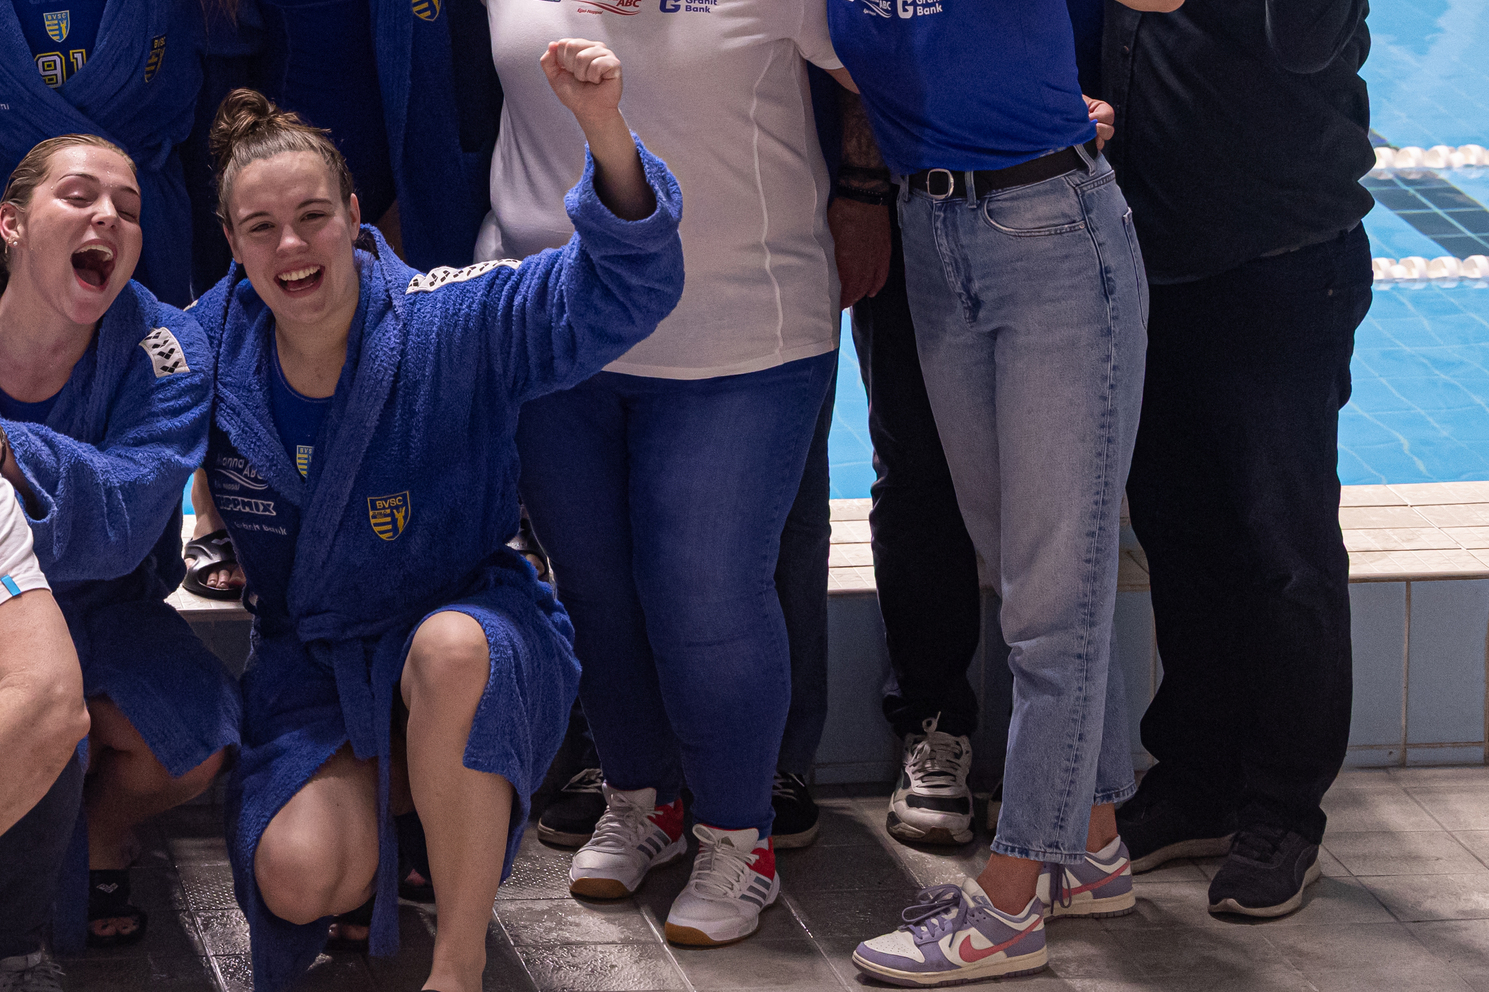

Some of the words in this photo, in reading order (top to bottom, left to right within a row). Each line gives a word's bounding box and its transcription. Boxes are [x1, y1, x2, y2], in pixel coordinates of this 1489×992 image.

[685, 4, 711, 13] Bank
[917, 3, 943, 16] Bank
[47, 12, 66, 20] BVSC
[34, 49, 87, 89] 91
[376, 497, 403, 509] BVSC
